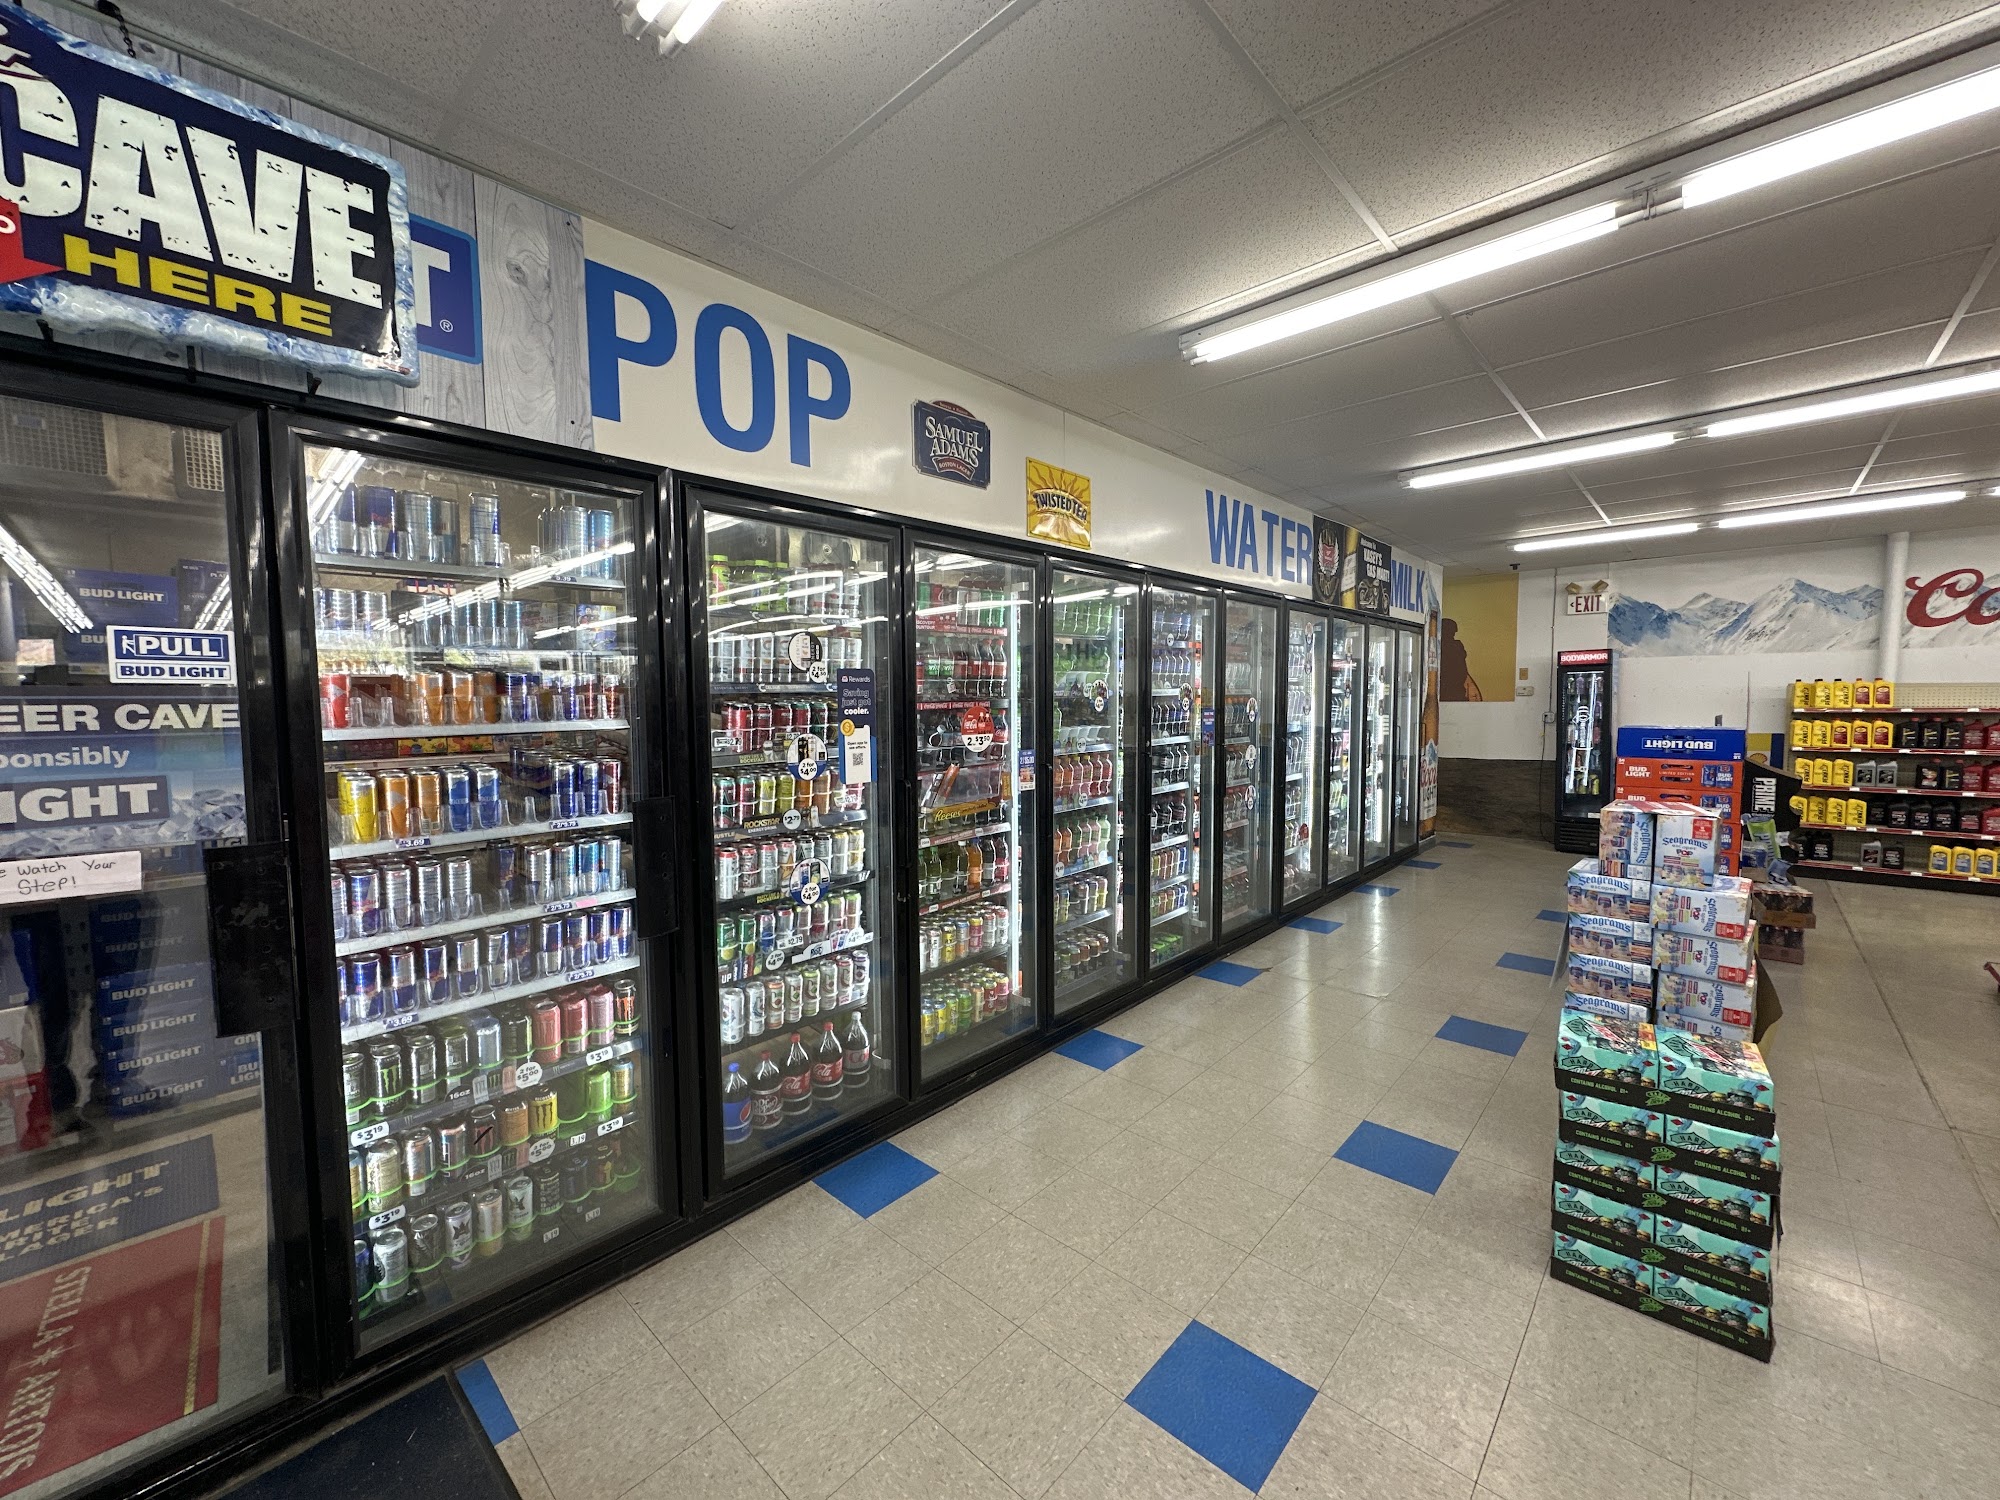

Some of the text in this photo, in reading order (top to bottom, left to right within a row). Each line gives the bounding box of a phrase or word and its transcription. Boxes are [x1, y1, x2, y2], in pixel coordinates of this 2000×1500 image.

[0, 62, 382, 309] CAVE
[64, 234, 332, 337] HERE
[585, 259, 851, 467] POP
[925, 416, 983, 452] SAMUEL
[930, 438, 979, 468] ADAMS
[938, 461, 957, 469] BOSTON
[1033, 491, 1088, 522] TWISTED TEA
[1205, 489, 1313, 586] WATER
[79, 588, 164, 602] BUD LIGHT
[1391, 559, 1425, 614] MILK
[1575, 594, 1602, 612] EXIT
[81, 635, 107, 644] BU
[138, 636, 219, 657] PULL
[1560, 652, 1608, 662] BODYARMOR
[120, 665, 228, 678] BUD LIGHT
[848, 675, 871, 684] Rewards
[841, 698, 857, 708] just
[843, 689, 869, 699] Saving
[114, 703, 241, 729] CAVE
[844, 706, 870, 716] cooler.
[967, 737, 972, 745] 2
[1644, 740, 1713, 750] BUD LIGHT
[1752, 777, 1777, 813] PRIME
[744, 818, 780, 829] ROCKSTAR
[405, 838, 425, 847] 3.69
[1636, 821, 1651, 864] Seagram's
[1662, 837, 1708, 850] Seagram's
[17, 858, 67, 876] Watch
[82, 860, 117, 871] Your
[18, 876, 77, 895] Step!
[1578, 875, 1630, 891] Seagram's
[1590, 884, 1617, 892] escapes
[1580, 916, 1631, 933] Seagram's
[1579, 956, 1631, 974] Seagram's
[112, 978, 195, 1001] BUD LIGHT
[1575, 996, 1627, 1015] Seagram's
[113, 1013, 197, 1037] BUD LIGHT
[393, 1015, 412, 1027] 3.69
[118, 1046, 201, 1071] BUD LIGHT
[1569, 1058, 1594, 1070] HARD
[122, 1079, 205, 1106] BUD LIGHT
[1570, 1078, 1617, 1093] CONTAINS ALCOHOL
[1671, 1079, 1701, 1093] HARD
[1574, 1109, 1598, 1122] HARD
[1688, 1102, 1742, 1120] CONTAINS ALCOHOL
[1575, 1130, 1622, 1147] CONTAINS ALCOHOL
[1680, 1135, 1707, 1148] HARD
[1567, 1153, 1591, 1165] HARD
[1694, 1159, 1748, 1179] CONTAINS ALCOHOL
[1568, 1171, 1613, 1190] CONTAINS ALCOHOL
[1669, 1183, 1697, 1196] HARD
[0, 1160, 169, 1223] LIGHT
[1566, 1203, 1591, 1215] HARD
[1684, 1208, 1737, 1230] CONTAINS ALCOHOL
[1567, 1224, 1613, 1244] CONTAINS ALCOHOL
[1668, 1236, 1696, 1250] HARD
[1566, 1252, 1590, 1265] HARD
[1565, 1269, 1610, 1292] CONTAINS ALCOHOL
[1683, 1264, 1737, 1289] CONTAINS ALCOHOL
[1666, 1289, 1694, 1303] HARD
[32, 1266, 92, 1349] STELLA
[1681, 1315, 1735, 1339] CONTAINS ALCOHOL
